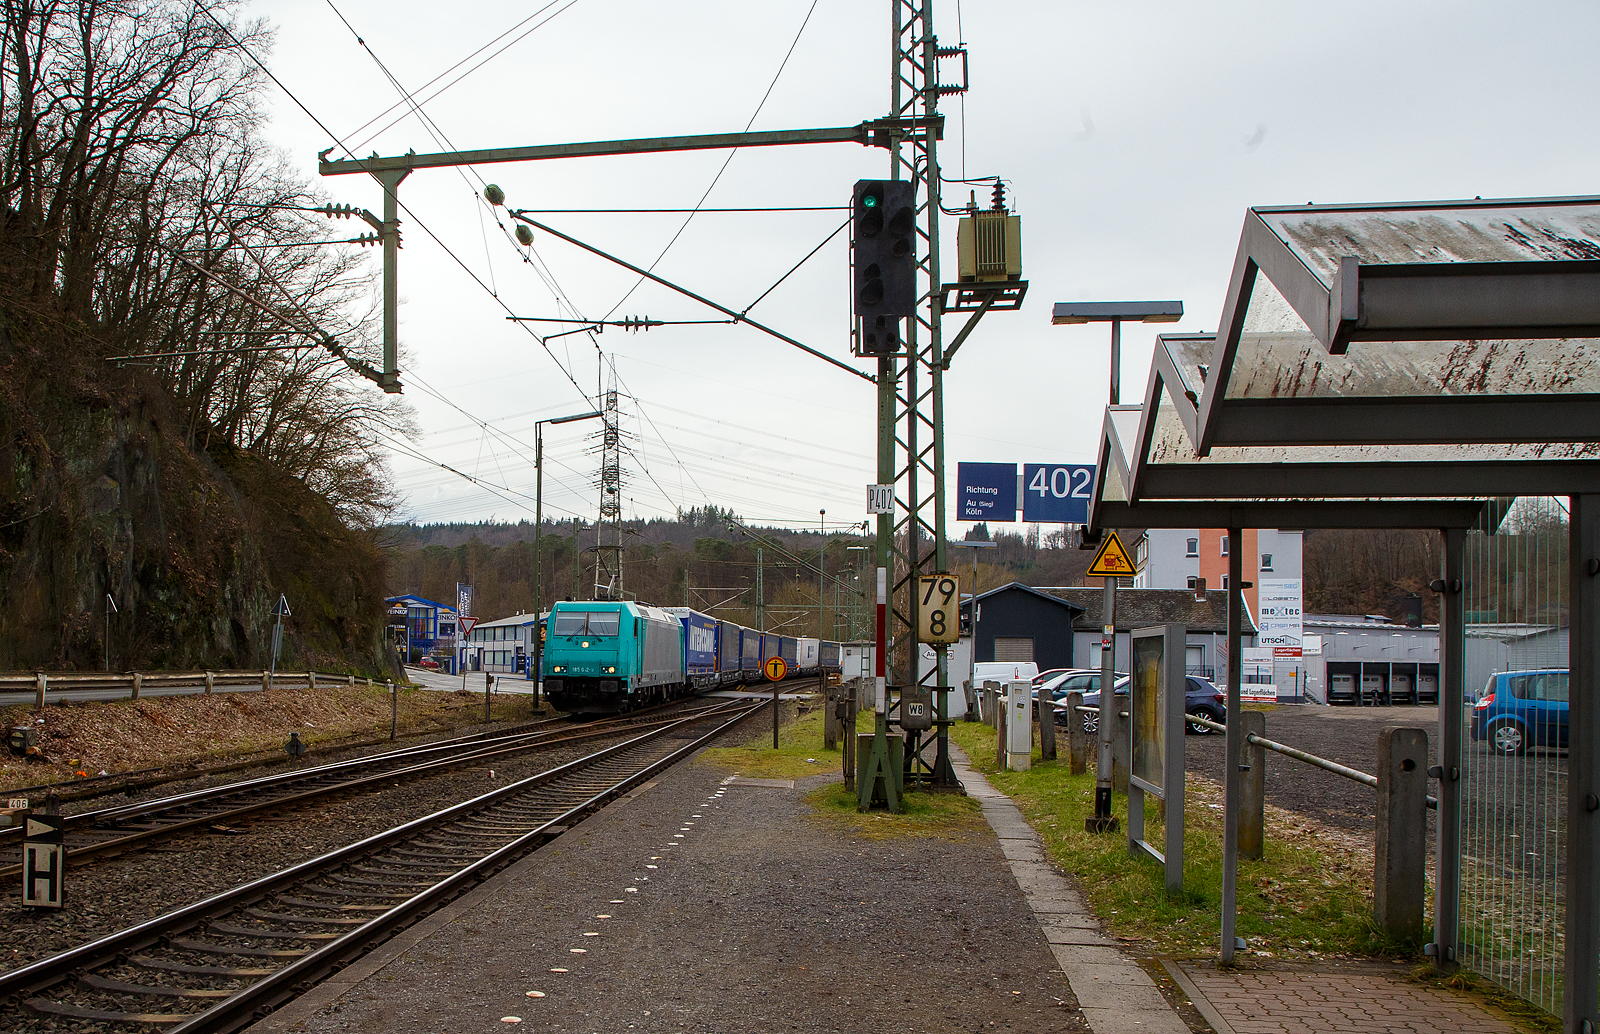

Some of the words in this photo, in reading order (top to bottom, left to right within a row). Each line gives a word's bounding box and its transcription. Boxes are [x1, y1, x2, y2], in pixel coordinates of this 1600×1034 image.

[966, 486, 998, 495] Richtung
[1028, 467, 1091, 498] 402
[869, 488, 892, 510] P402
[966, 499, 977, 507] Au
[921, 578, 956, 606] 79
[930, 609, 946, 637] 8
[909, 704, 923, 715] W8
[10, 800, 27, 808] 406
[27, 847, 58, 902] H
